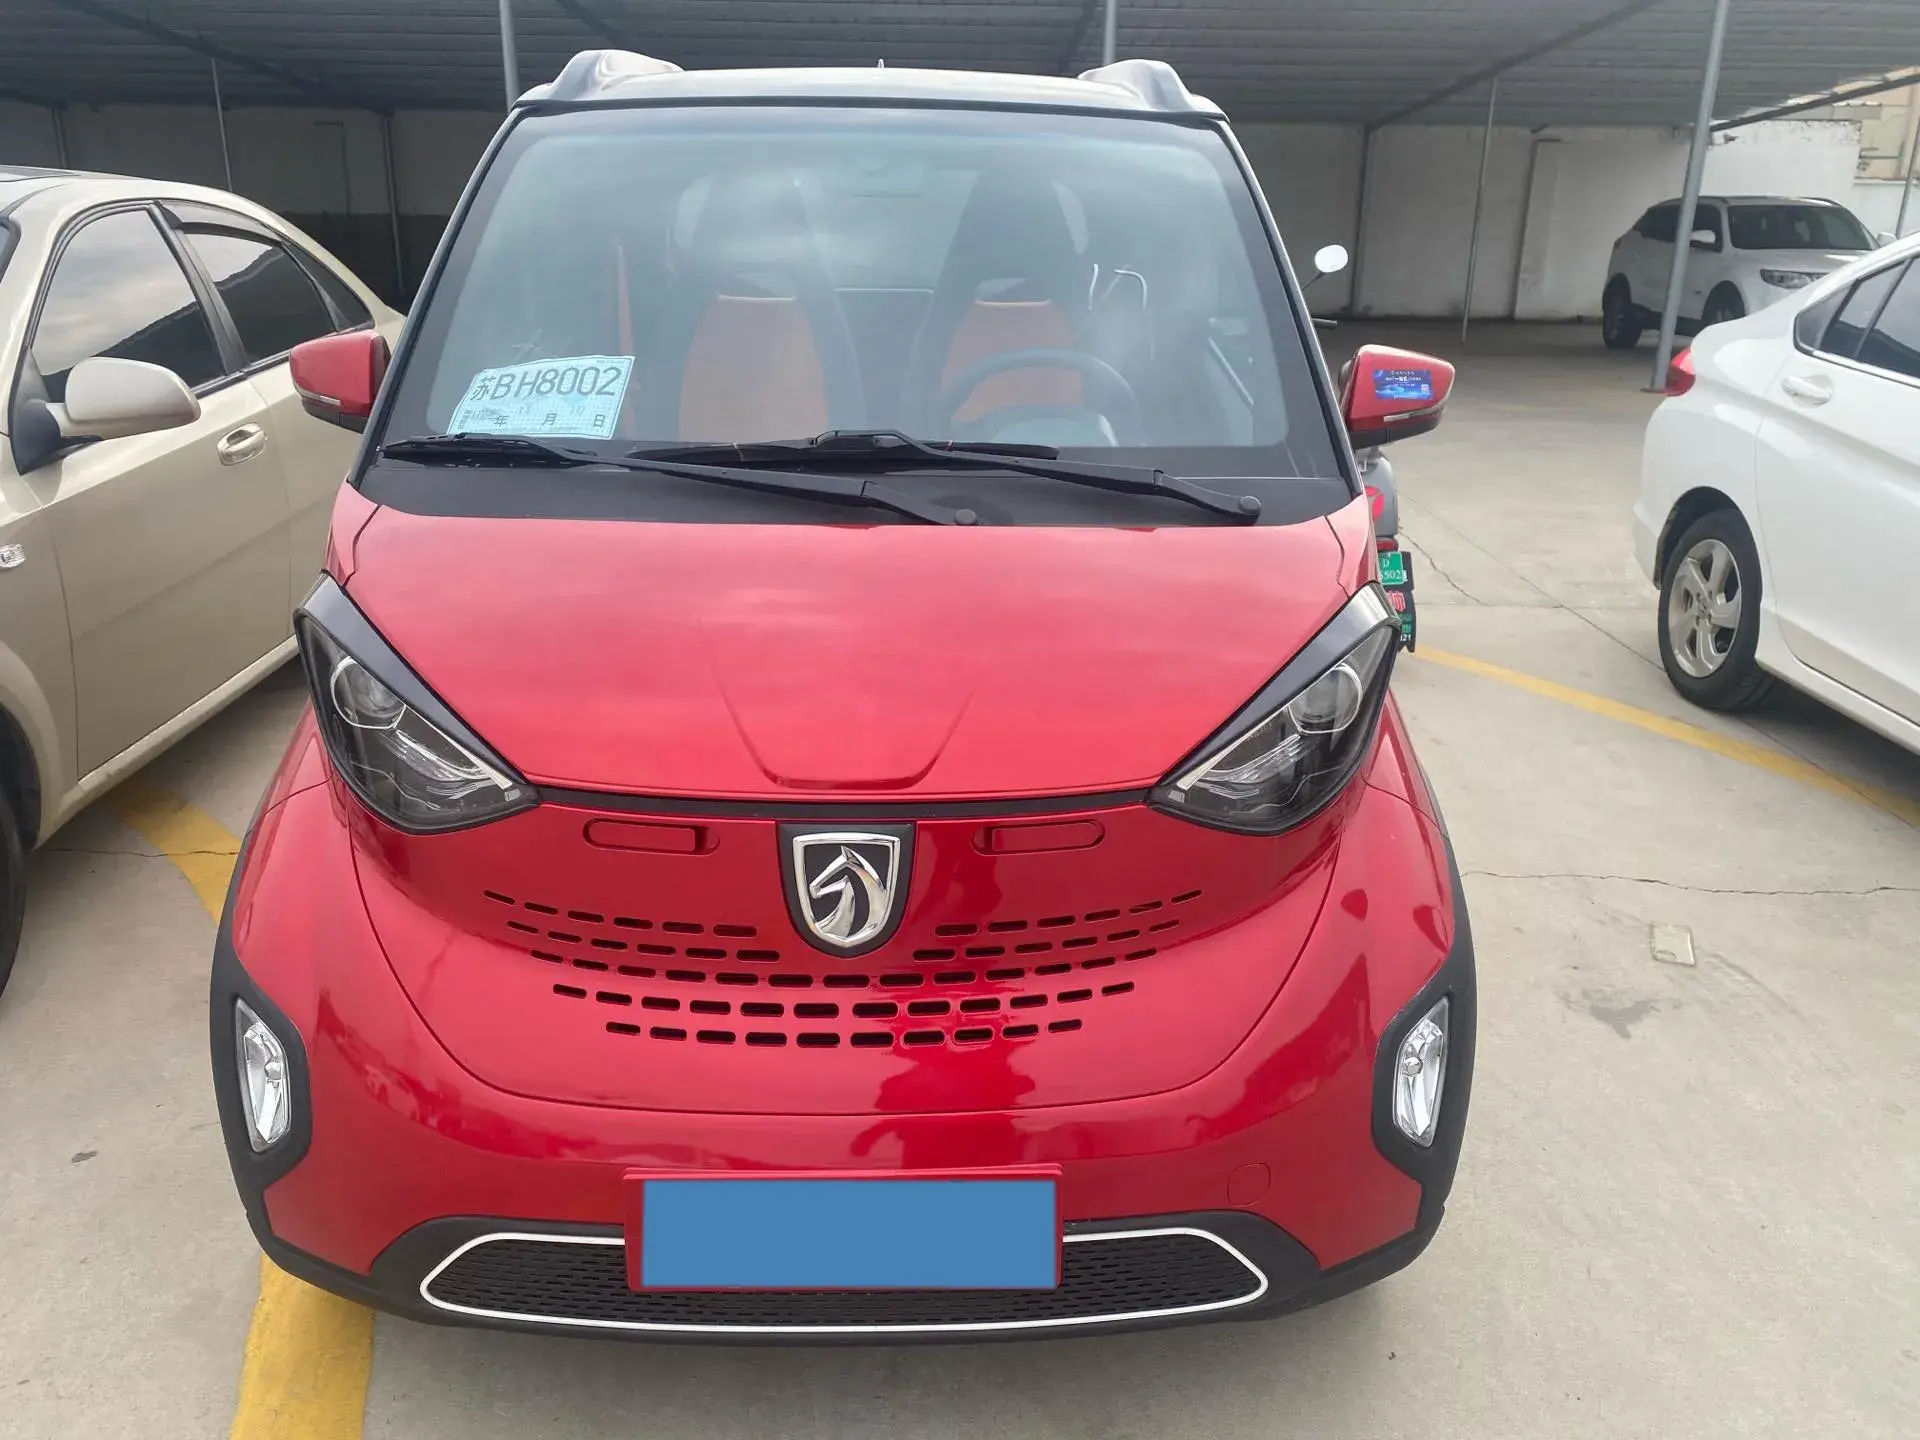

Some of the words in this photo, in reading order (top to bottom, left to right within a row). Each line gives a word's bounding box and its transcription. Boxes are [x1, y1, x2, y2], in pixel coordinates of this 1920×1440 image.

[470, 366, 622, 401] 苏BH8002
[542, 413, 557, 426] 月
[593, 414, 605, 429] 日
